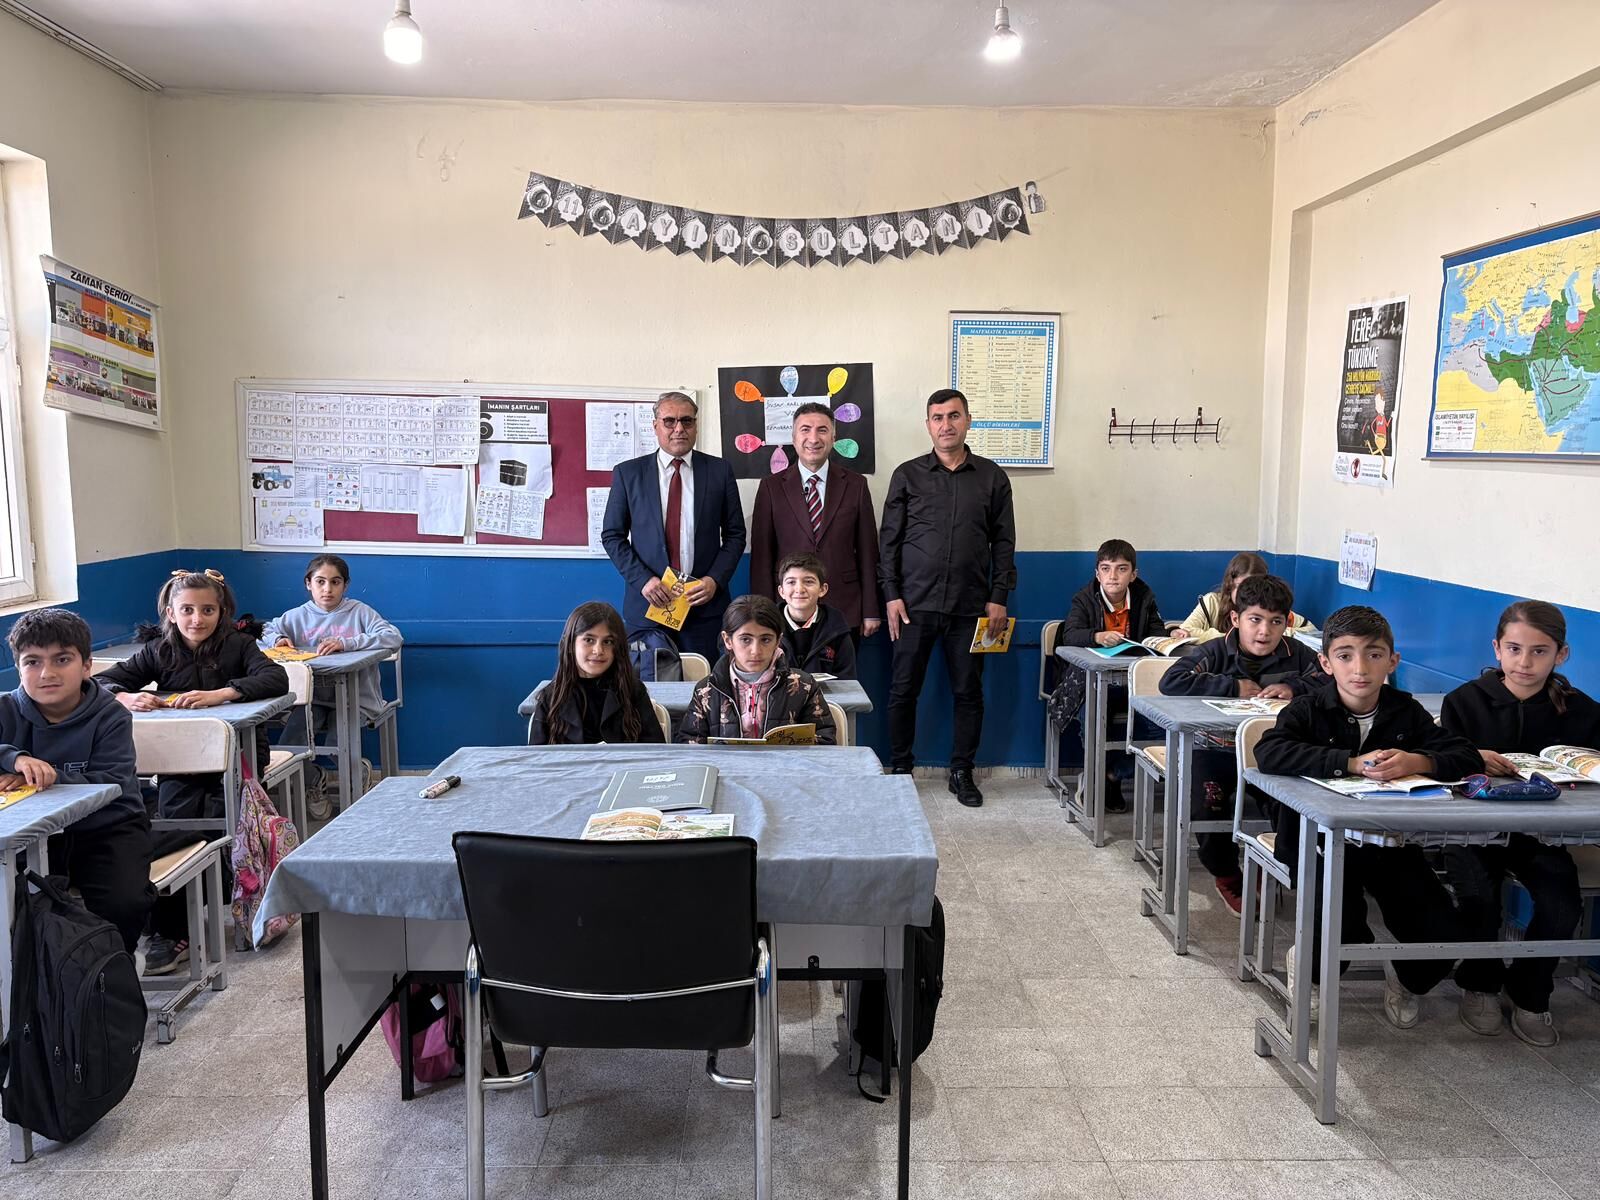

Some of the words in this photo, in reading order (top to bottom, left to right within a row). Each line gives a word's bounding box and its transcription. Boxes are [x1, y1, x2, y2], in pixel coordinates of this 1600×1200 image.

[563, 196, 579, 216] 11
[626, 212, 737, 248] AYIN
[785, 211, 985, 251] SULTANI
[69, 270, 103, 291] ZAMAN
[103, 284, 133, 305] ŞERİDİ
[1347, 344, 1380, 369] TÜKÜRME
[487, 402, 510, 410] İMANIN
